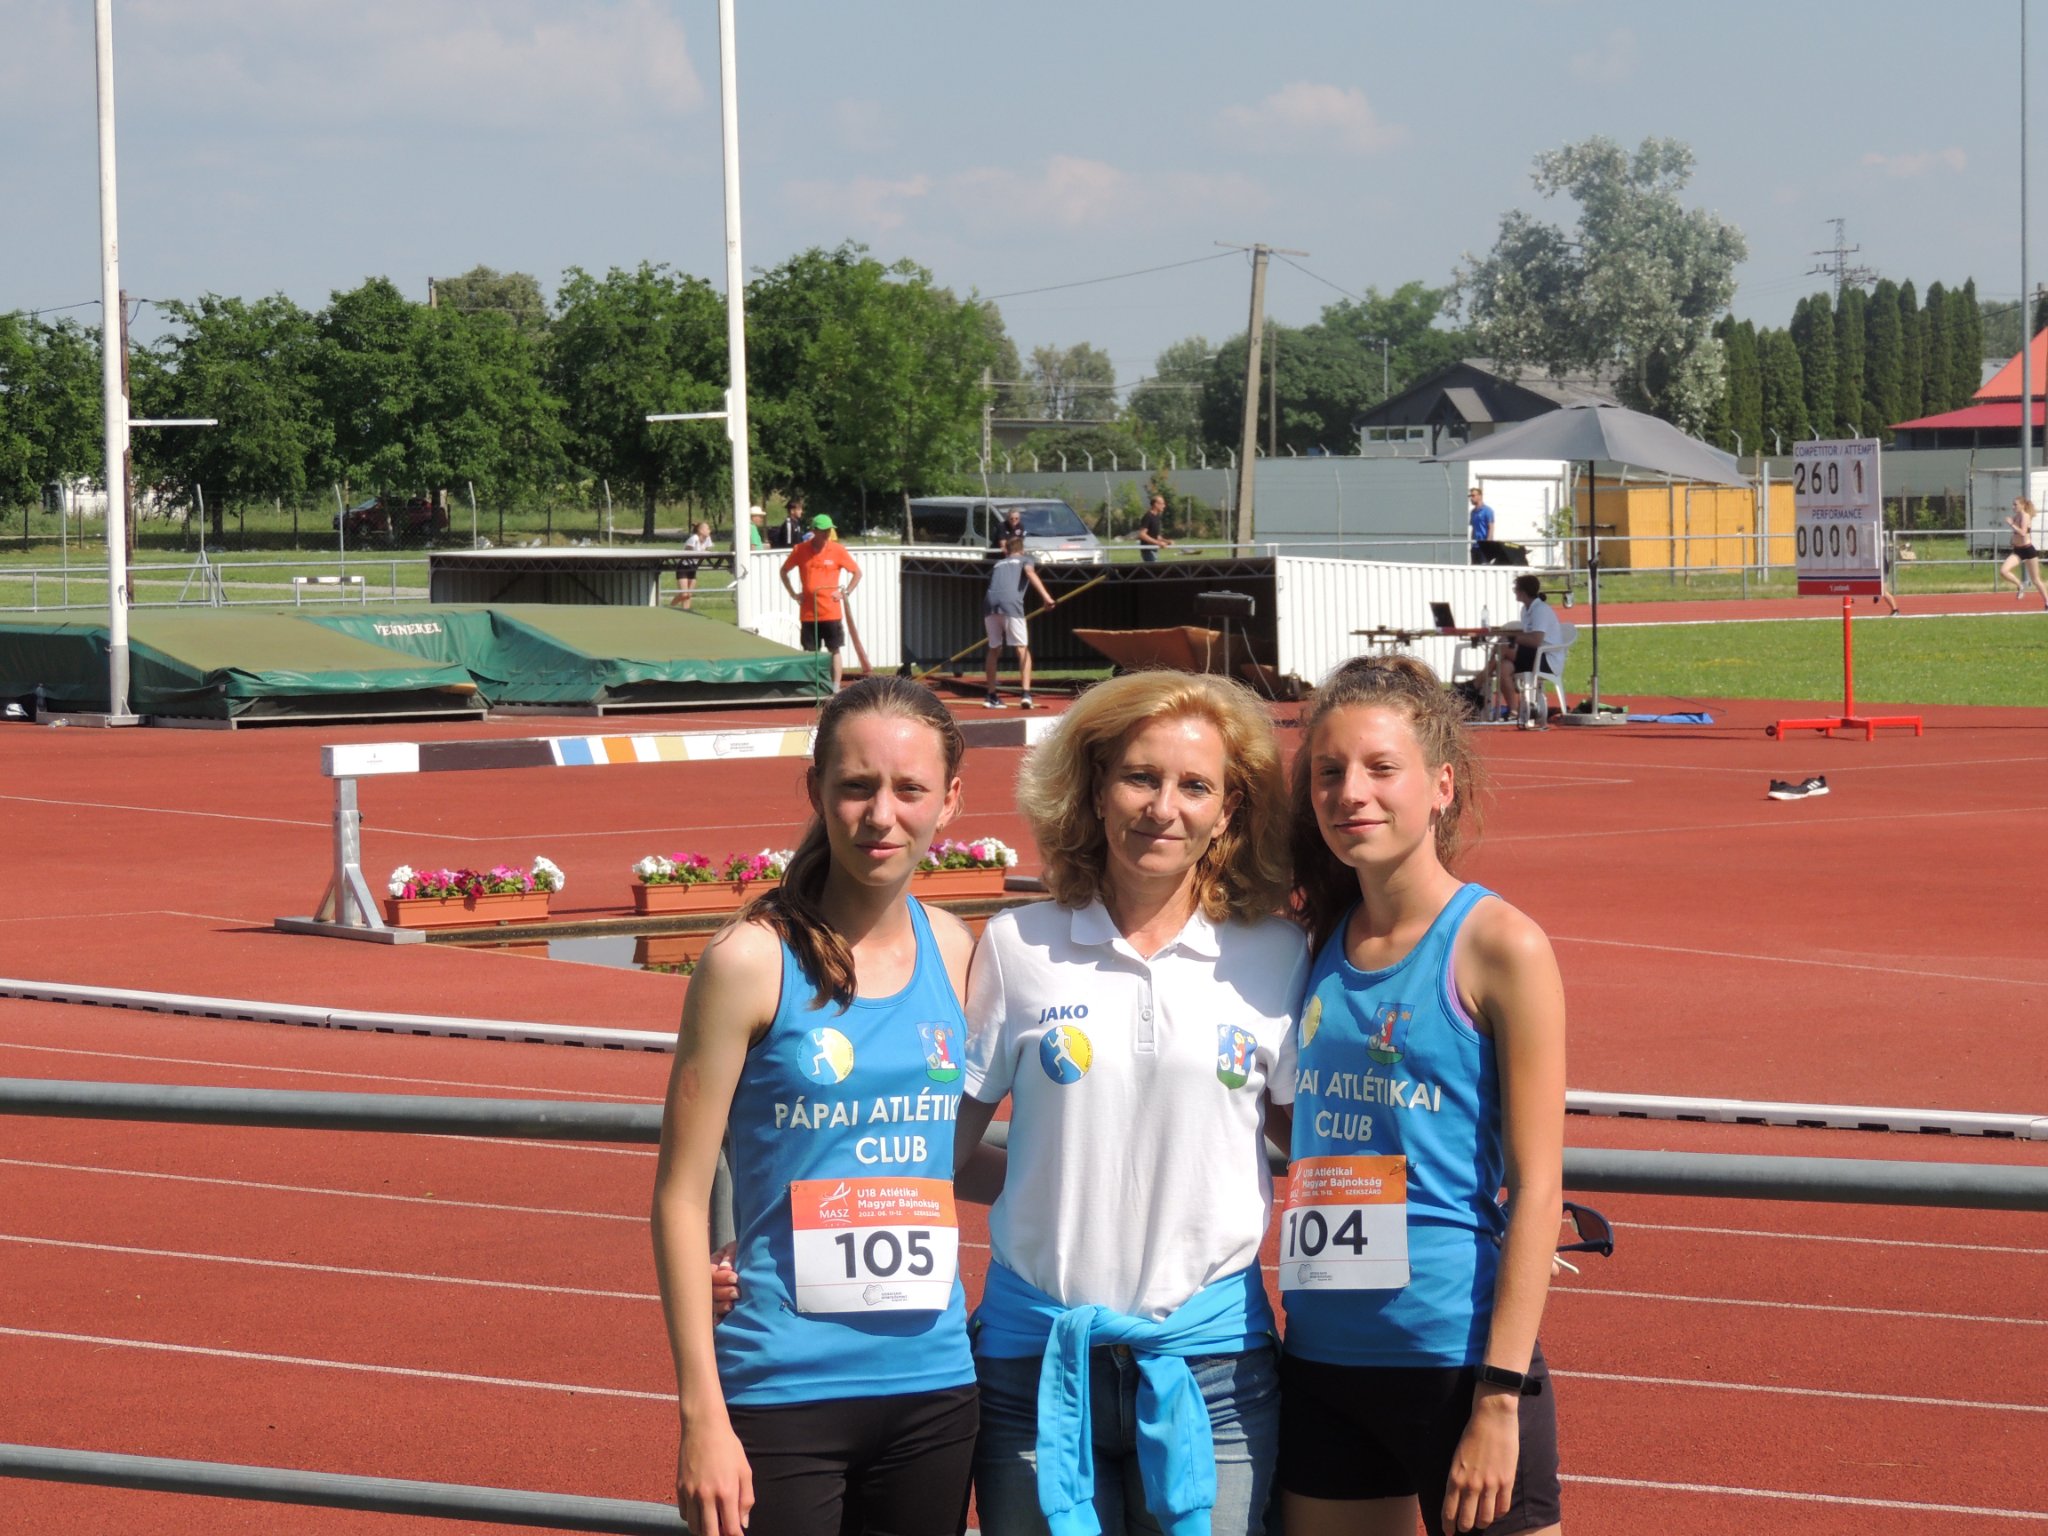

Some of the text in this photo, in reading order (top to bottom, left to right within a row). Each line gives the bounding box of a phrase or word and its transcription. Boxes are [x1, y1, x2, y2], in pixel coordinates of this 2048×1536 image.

[1795, 445, 1838, 457] COMPETITOR
[1845, 444, 1877, 456] ATTEMPT
[1794, 460, 1863, 495] 260 1
[1811, 508, 1863, 520] PERFORMANCE
[1039, 1004, 1089, 1024] JAKO
[1325, 1068, 1441, 1112] ATLÉTIKAI
[774, 1096, 859, 1129] PÁPAI
[1314, 1110, 1373, 1142] CLUB
[855, 1135, 928, 1164] CLUB
[1315, 1166, 1353, 1177] Atlétikai
[857, 1187, 919, 1198] U18 Atlétikai
[1330, 1177, 1382, 1189] Bajnokság
[820, 1208, 850, 1218] MASZ
[858, 1198, 940, 1211] Magyar Bajnokság
[1289, 1209, 1368, 1258] 104
[835, 1230, 934, 1278] 105
